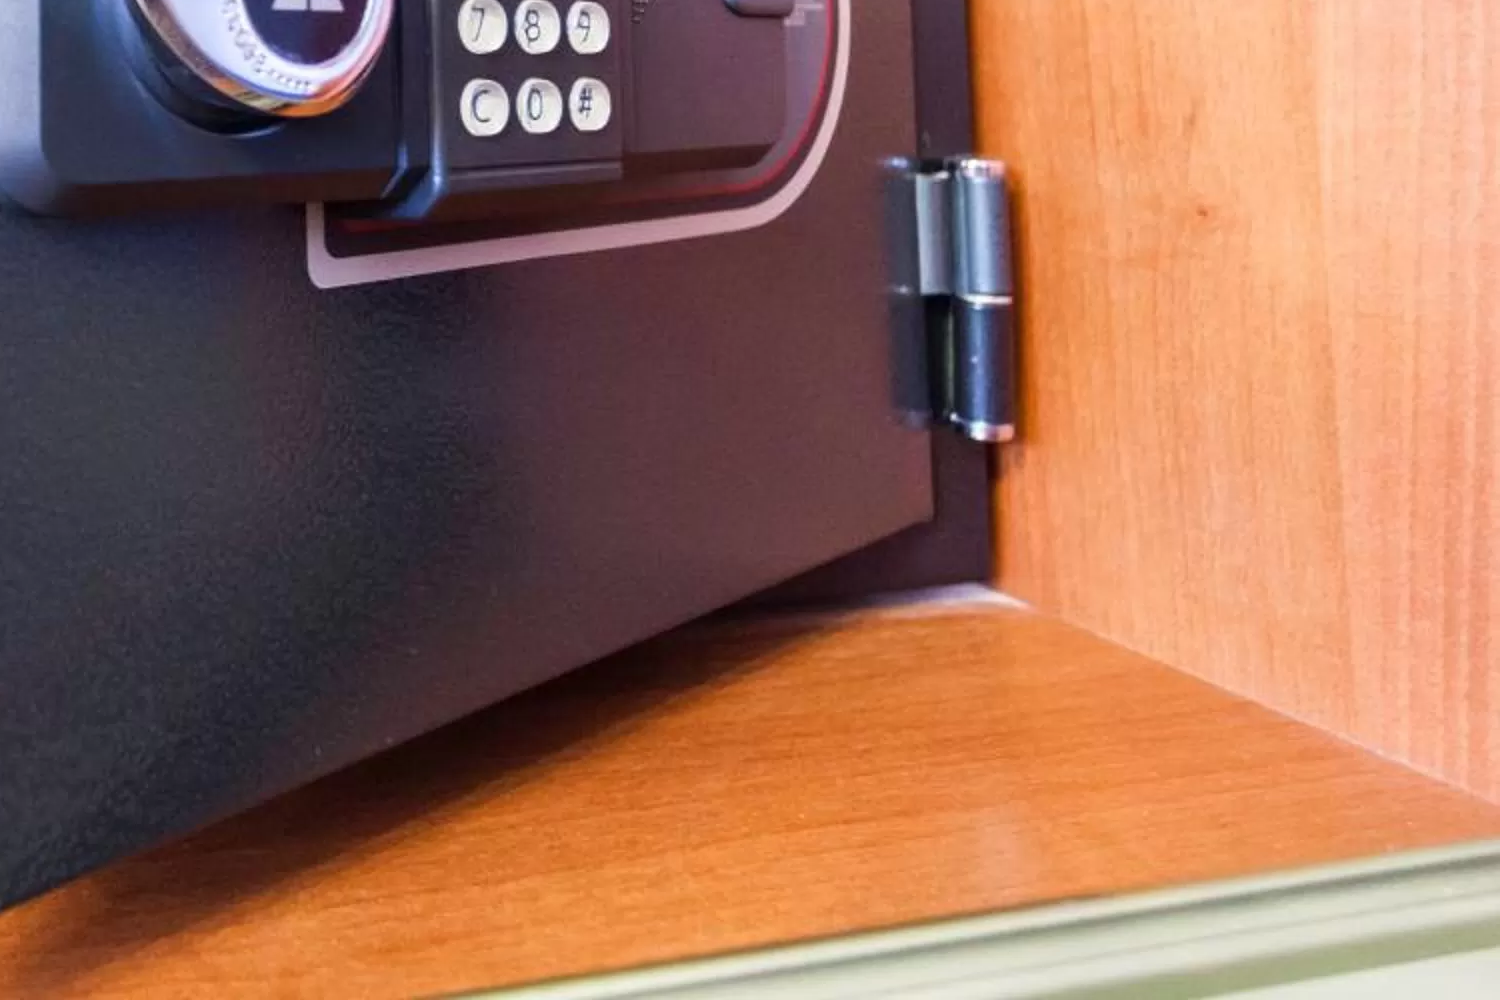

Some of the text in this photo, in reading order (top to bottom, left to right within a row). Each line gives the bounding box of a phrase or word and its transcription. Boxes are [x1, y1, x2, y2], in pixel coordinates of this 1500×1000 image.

[471, 7, 592, 47] 7 8 9
[470, 88, 492, 124] C
